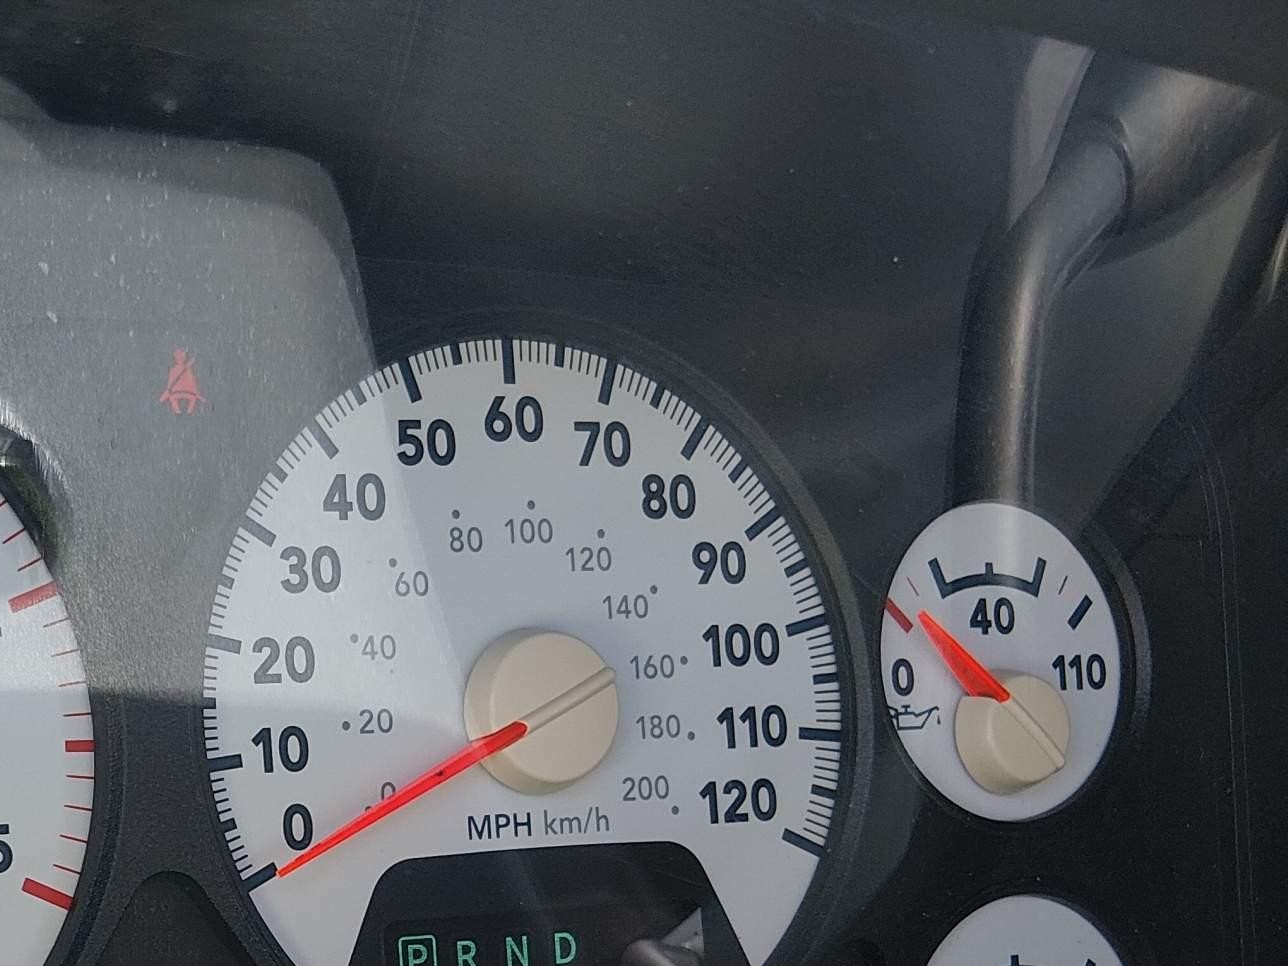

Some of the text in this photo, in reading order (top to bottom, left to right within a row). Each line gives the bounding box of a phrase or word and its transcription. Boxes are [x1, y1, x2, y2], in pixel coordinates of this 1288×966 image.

[484, 396, 544, 442] 60
[397, 419, 456, 466] 50
[573, 421, 632, 467] 70
[323, 473, 387, 520] 40
[641, 474, 696, 519] 80
[449, 526, 484, 553] 80
[504, 518, 554, 544] 100
[280, 546, 342, 593] 30
[565, 546, 613, 572] 120
[691, 541, 747, 584] 90
[394, 571, 430, 598] 60
[602, 594, 649, 620] 140
[969, 597, 1016, 635] 40
[252, 636, 315, 684] 20
[360, 634, 397, 661] 40
[702, 624, 780, 667] 100
[630, 655, 676, 680] 160
[891, 658, 915, 697] 0
[1051, 653, 1107, 691] 110
[358, 709, 394, 734] 20
[636, 716, 681, 740] 180
[716, 704, 787, 749] 110
[252, 726, 309, 773] 10
[622, 775, 671, 801] 200
[699, 780, 778, 825] 120
[283, 803, 314, 851] 0
[467, 806, 611, 840] MPH km/h
[554, 932, 577, 965] D
